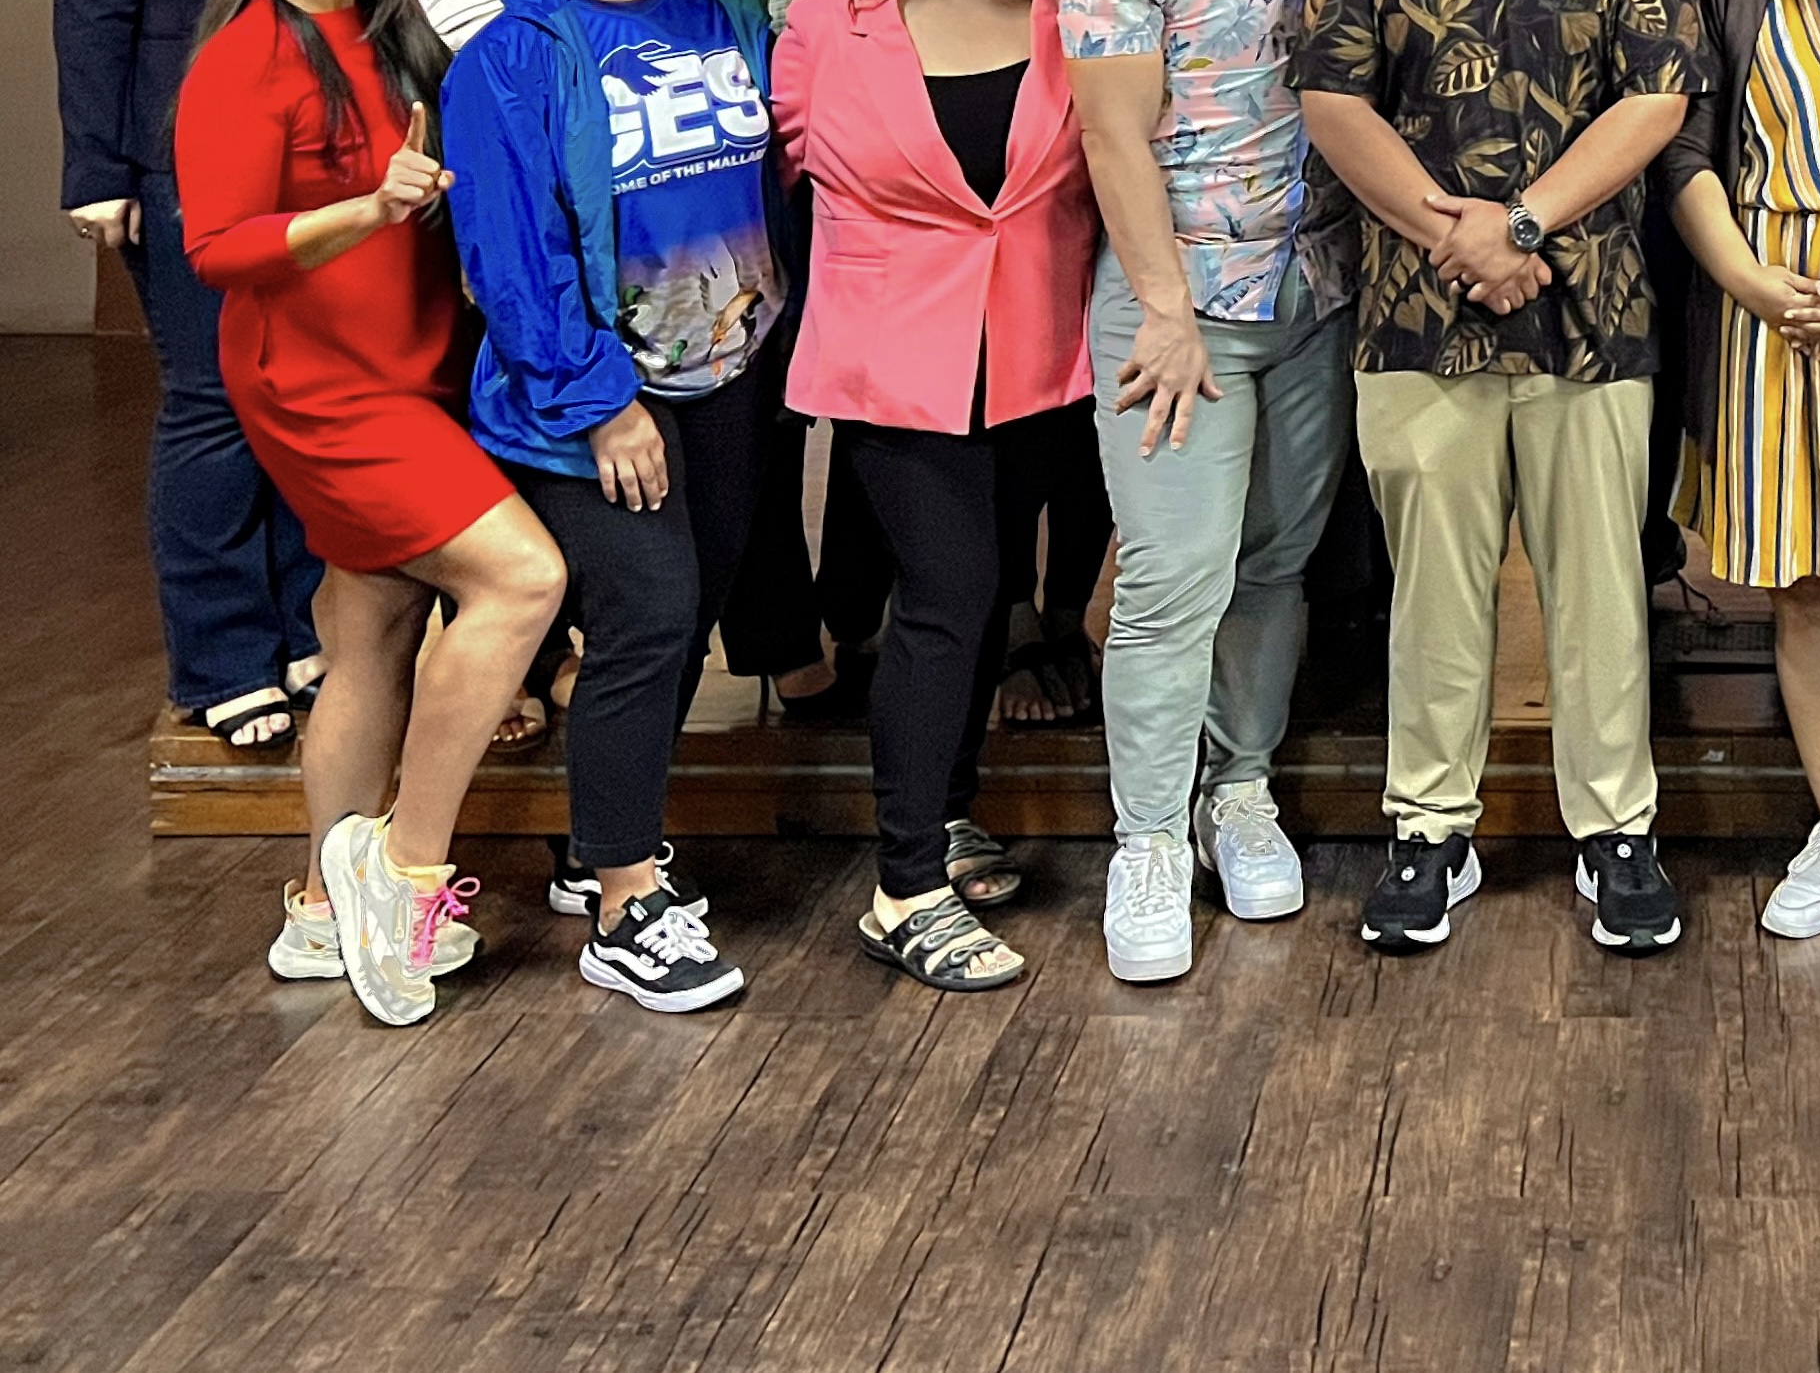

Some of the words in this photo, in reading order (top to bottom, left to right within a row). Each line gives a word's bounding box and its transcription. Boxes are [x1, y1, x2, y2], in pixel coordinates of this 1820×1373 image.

[611, 177, 648, 195] OME
[649, 169, 671, 185] OF
[672, 161, 706, 179] THE
